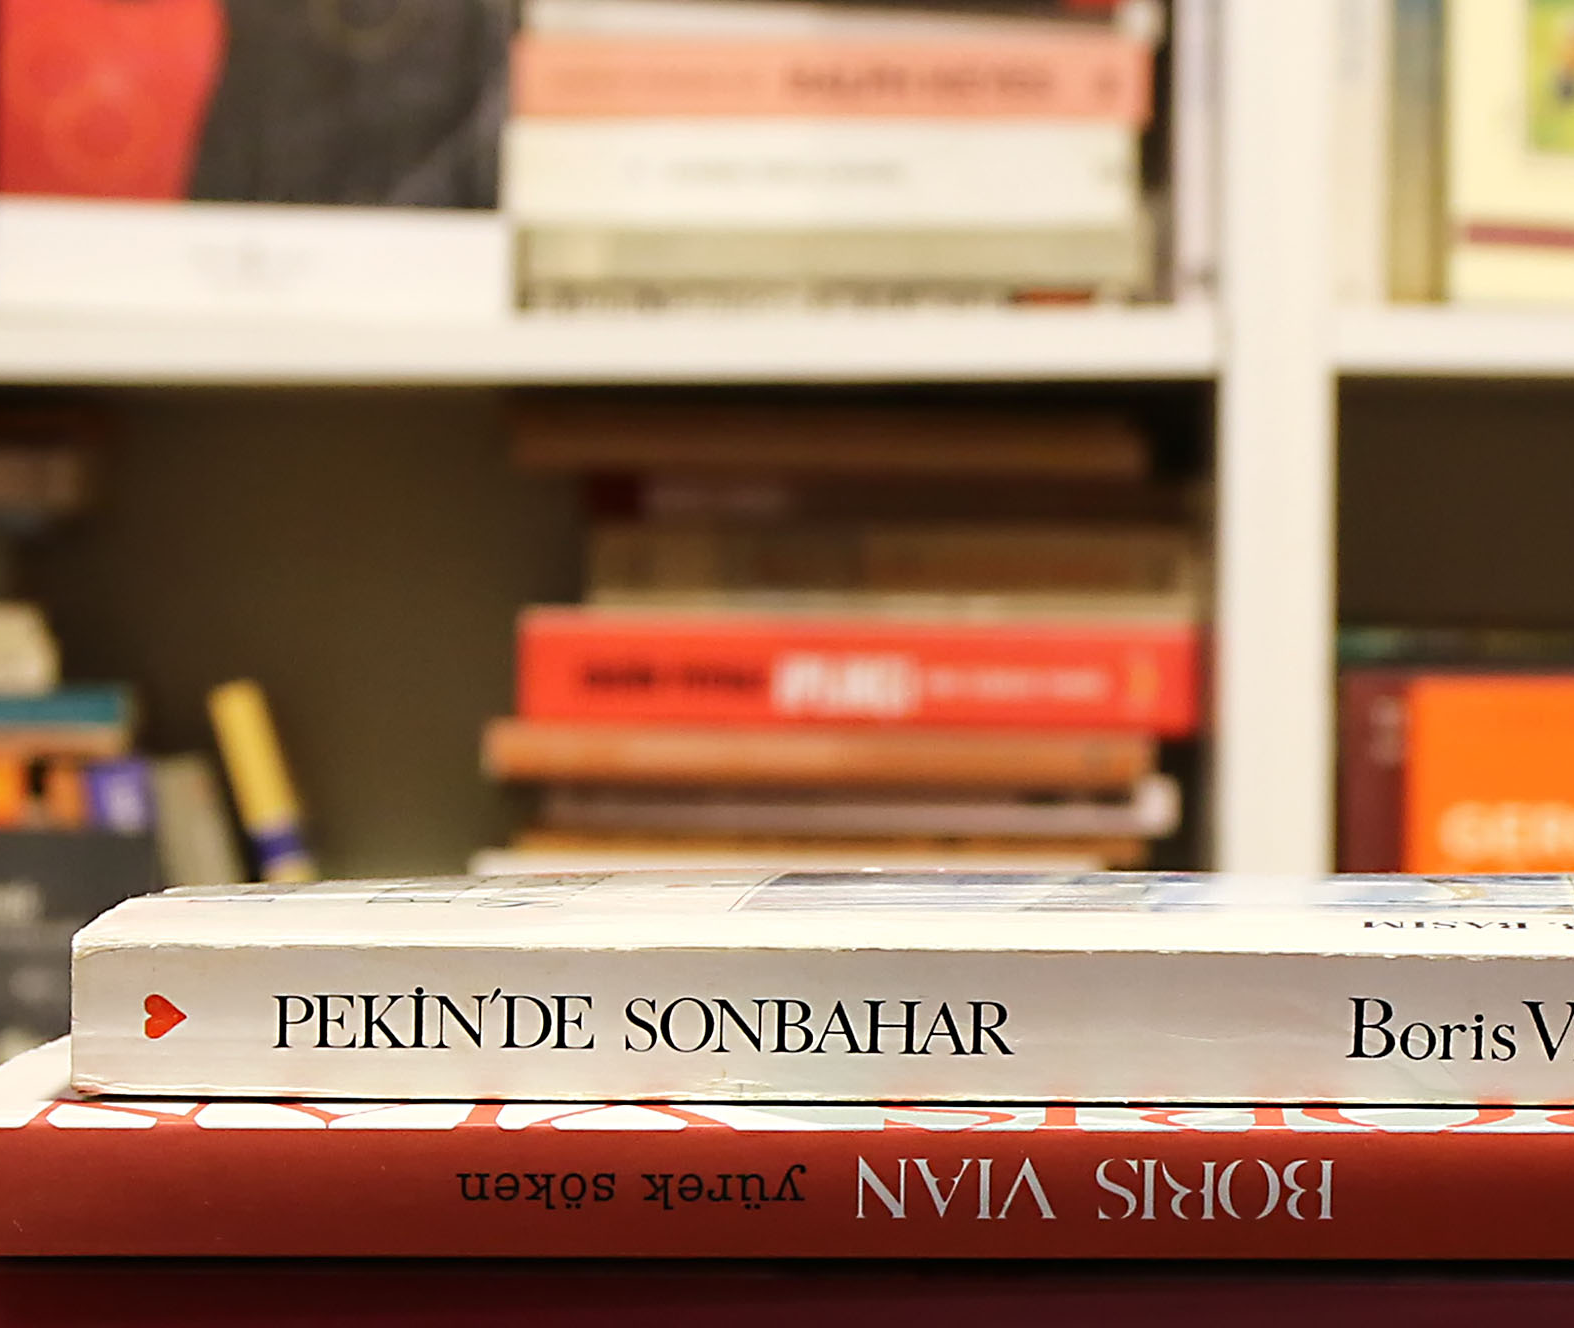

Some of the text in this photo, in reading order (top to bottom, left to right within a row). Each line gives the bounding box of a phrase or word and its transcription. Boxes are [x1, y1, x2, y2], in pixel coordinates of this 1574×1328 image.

[273, 986, 1014, 1055] PEKİN'DE SONBAHAR
[1347, 997, 1517, 1062] Boris
[456, 1163, 805, 1210] yürek söken
[856, 1155, 1334, 1221] BORIS VIAN
